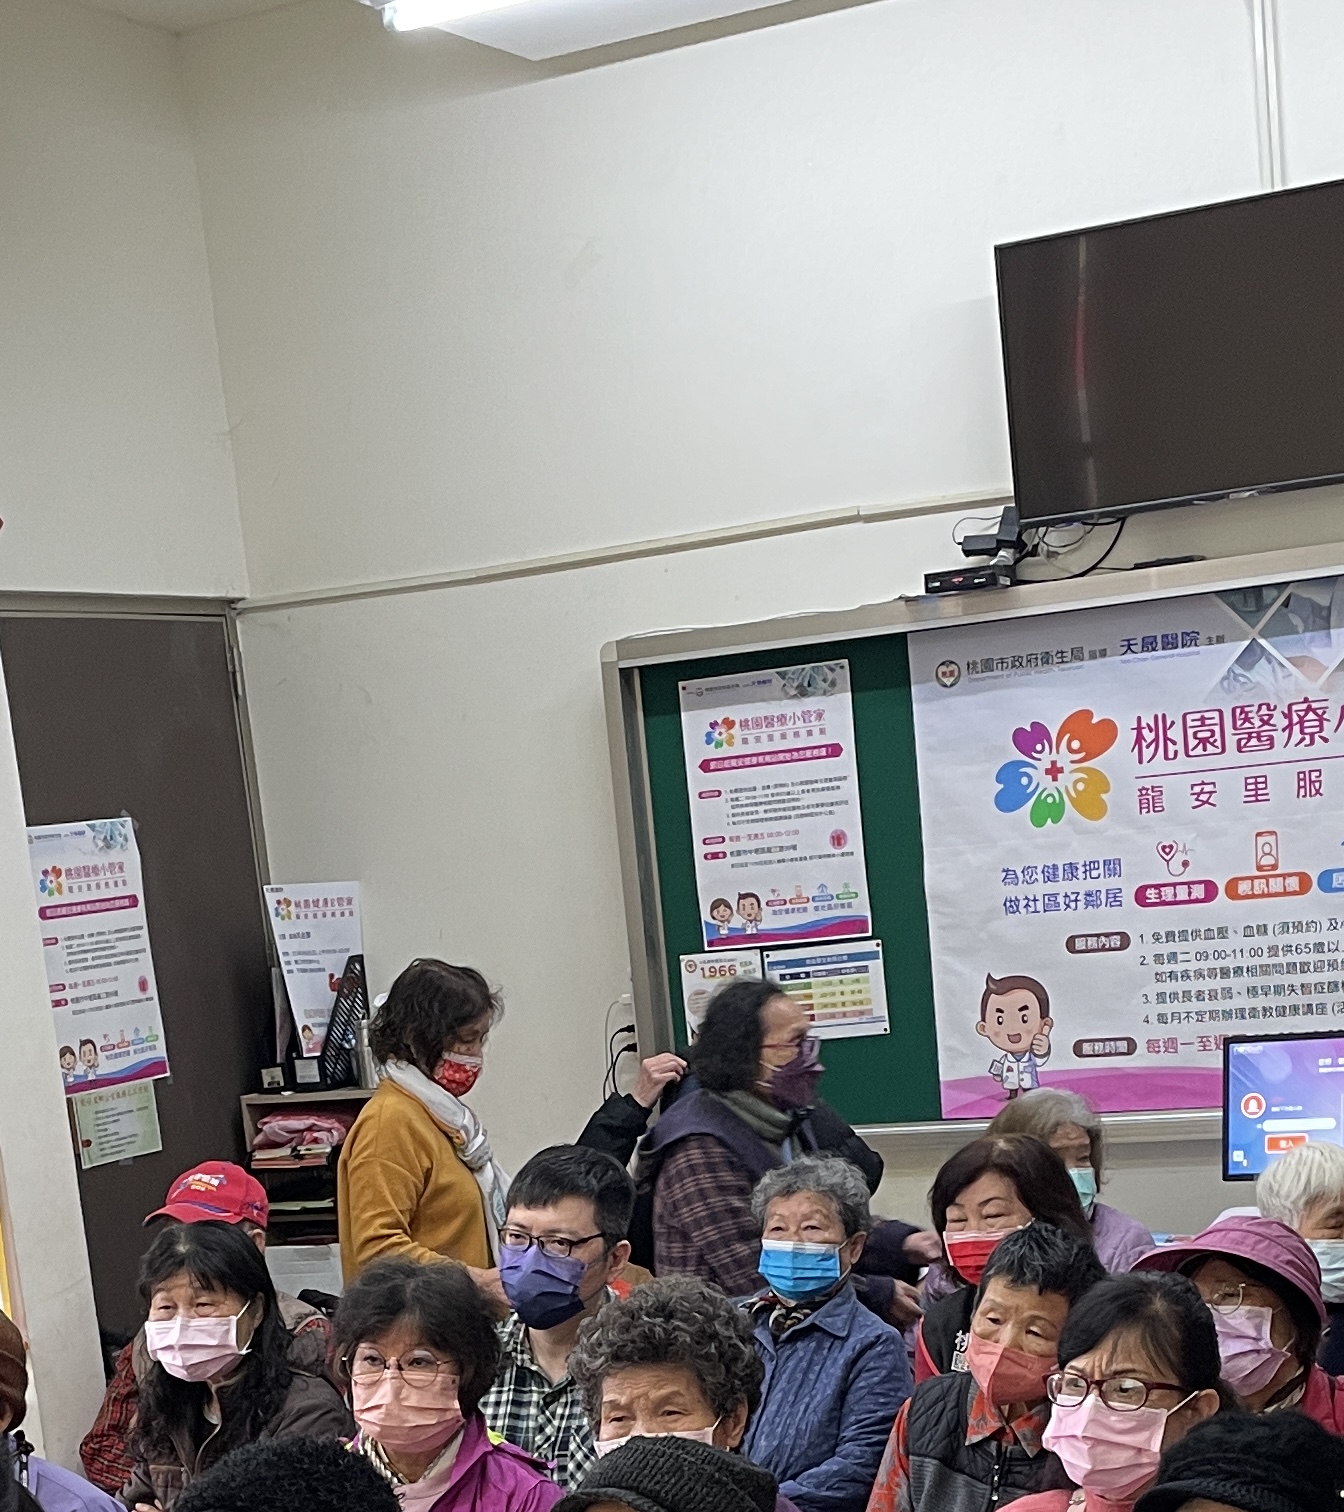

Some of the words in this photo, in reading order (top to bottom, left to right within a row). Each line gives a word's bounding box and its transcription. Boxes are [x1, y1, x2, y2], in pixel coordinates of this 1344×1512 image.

[966, 646, 1086, 676] 桃園市政府衛生局
[1120, 630, 1201, 656] 天晟醫院
[1001, 858, 1123, 887] 為您健康把關
[1002, 887, 1124, 916] 做社區好鄰居
[700, 964, 738, 978] 1966
